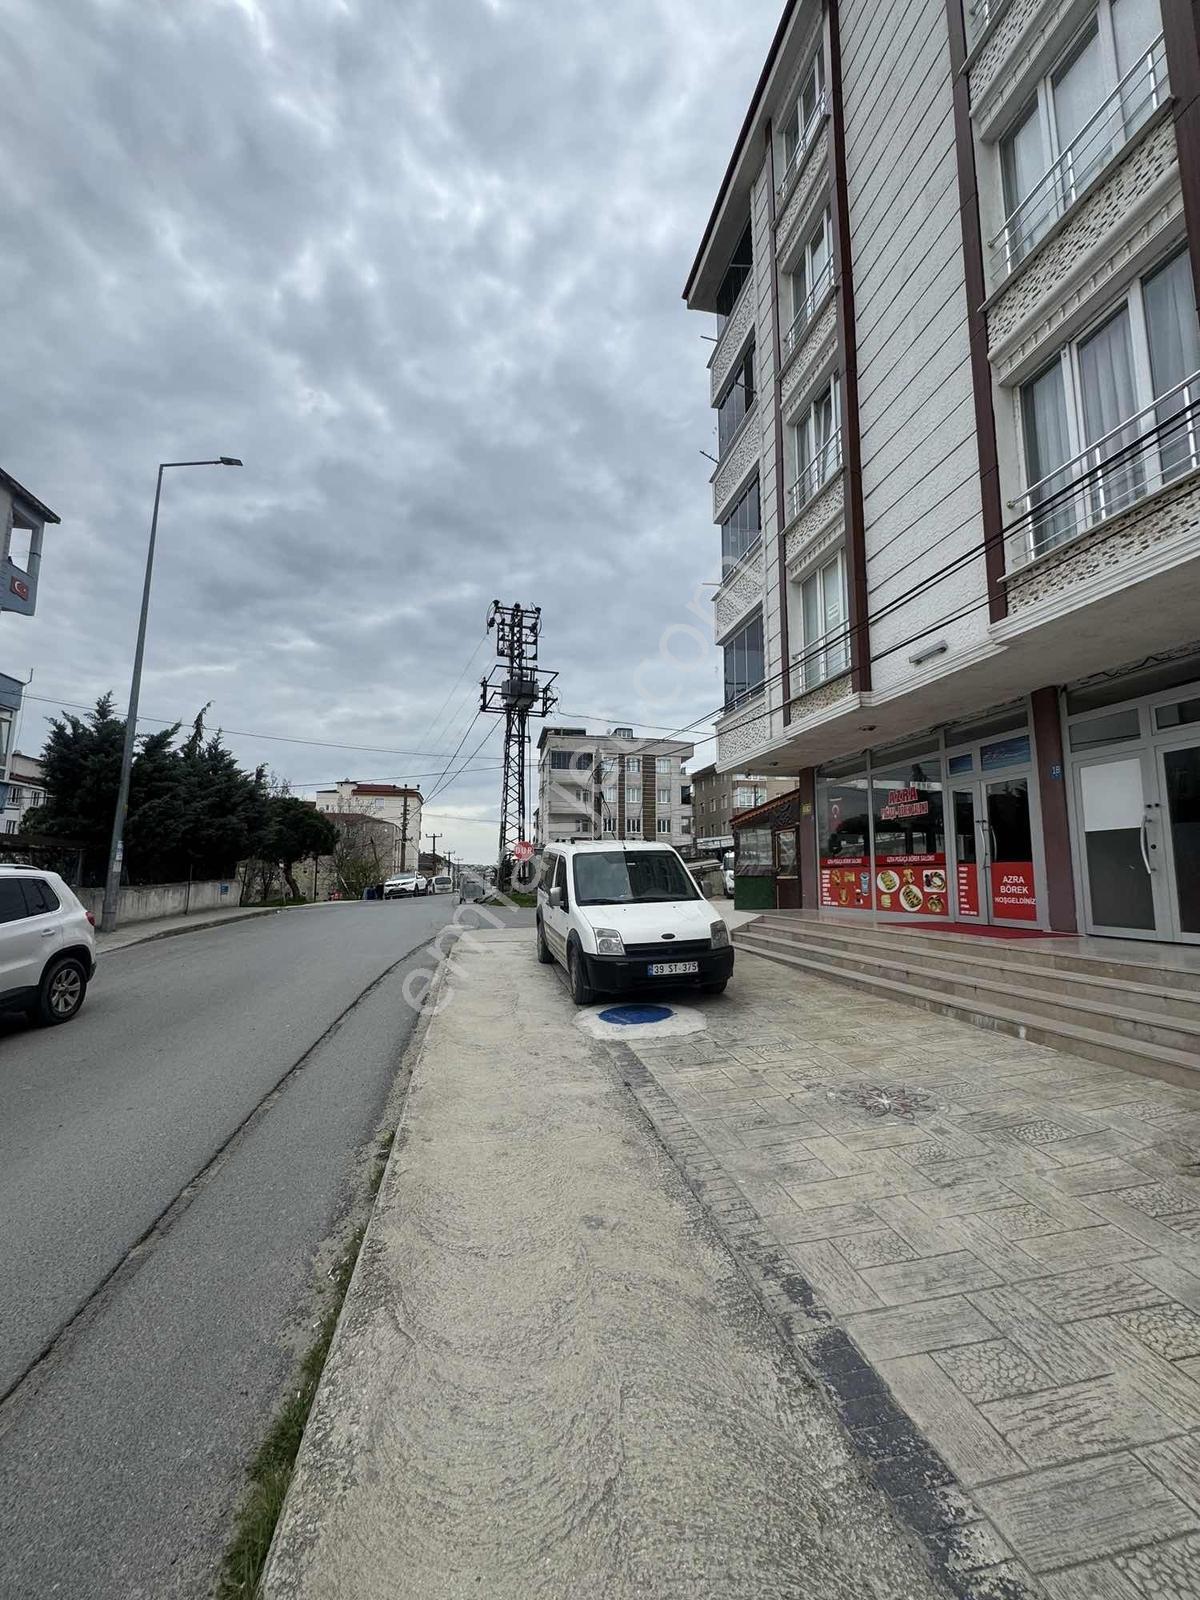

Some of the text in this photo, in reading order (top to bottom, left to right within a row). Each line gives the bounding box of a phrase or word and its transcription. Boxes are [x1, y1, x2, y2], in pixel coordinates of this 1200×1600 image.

[888, 787, 918, 806] AZRA
[515, 845, 533, 855] DUR
[1002, 875, 1025, 884] AZRA
[1000, 884, 1029, 894] BÖREK
[654, 962, 697, 974] 39 ST 375
